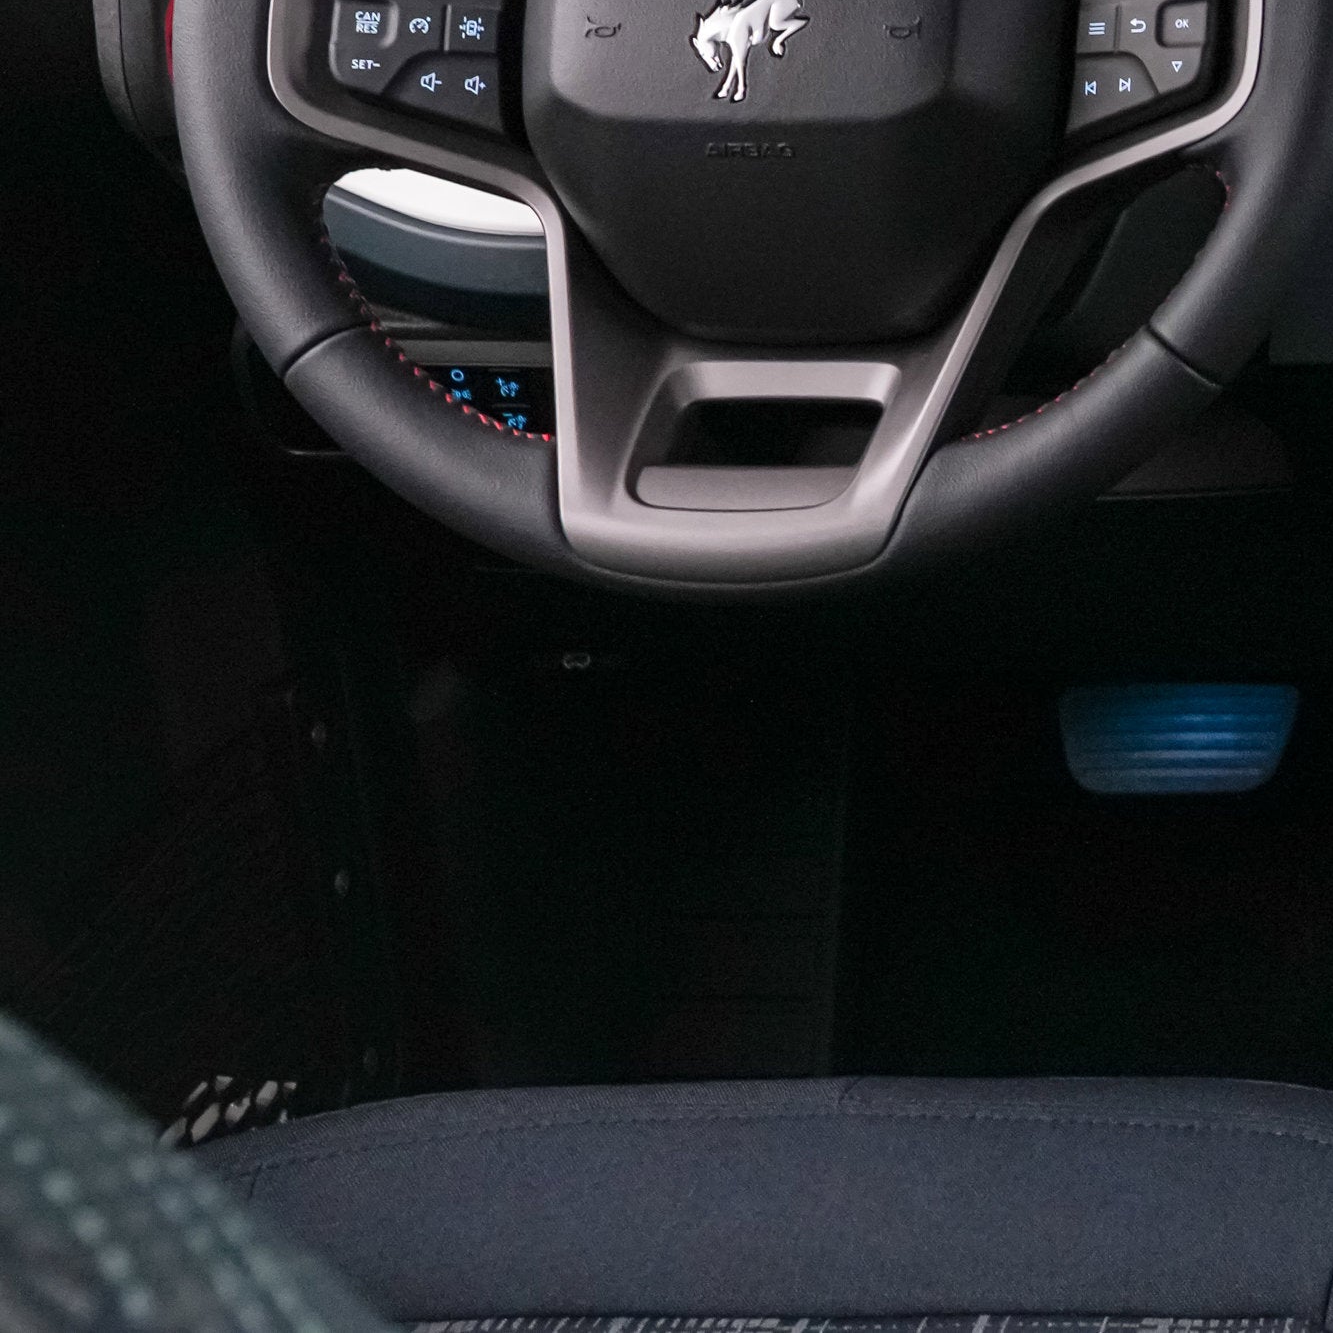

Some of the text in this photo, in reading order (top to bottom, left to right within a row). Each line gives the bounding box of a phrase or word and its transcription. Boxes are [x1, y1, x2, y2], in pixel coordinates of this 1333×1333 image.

[355, 10, 381, 23] CAN
[356, 23, 379, 35] RES
[1175, 17, 1189, 30] OK
